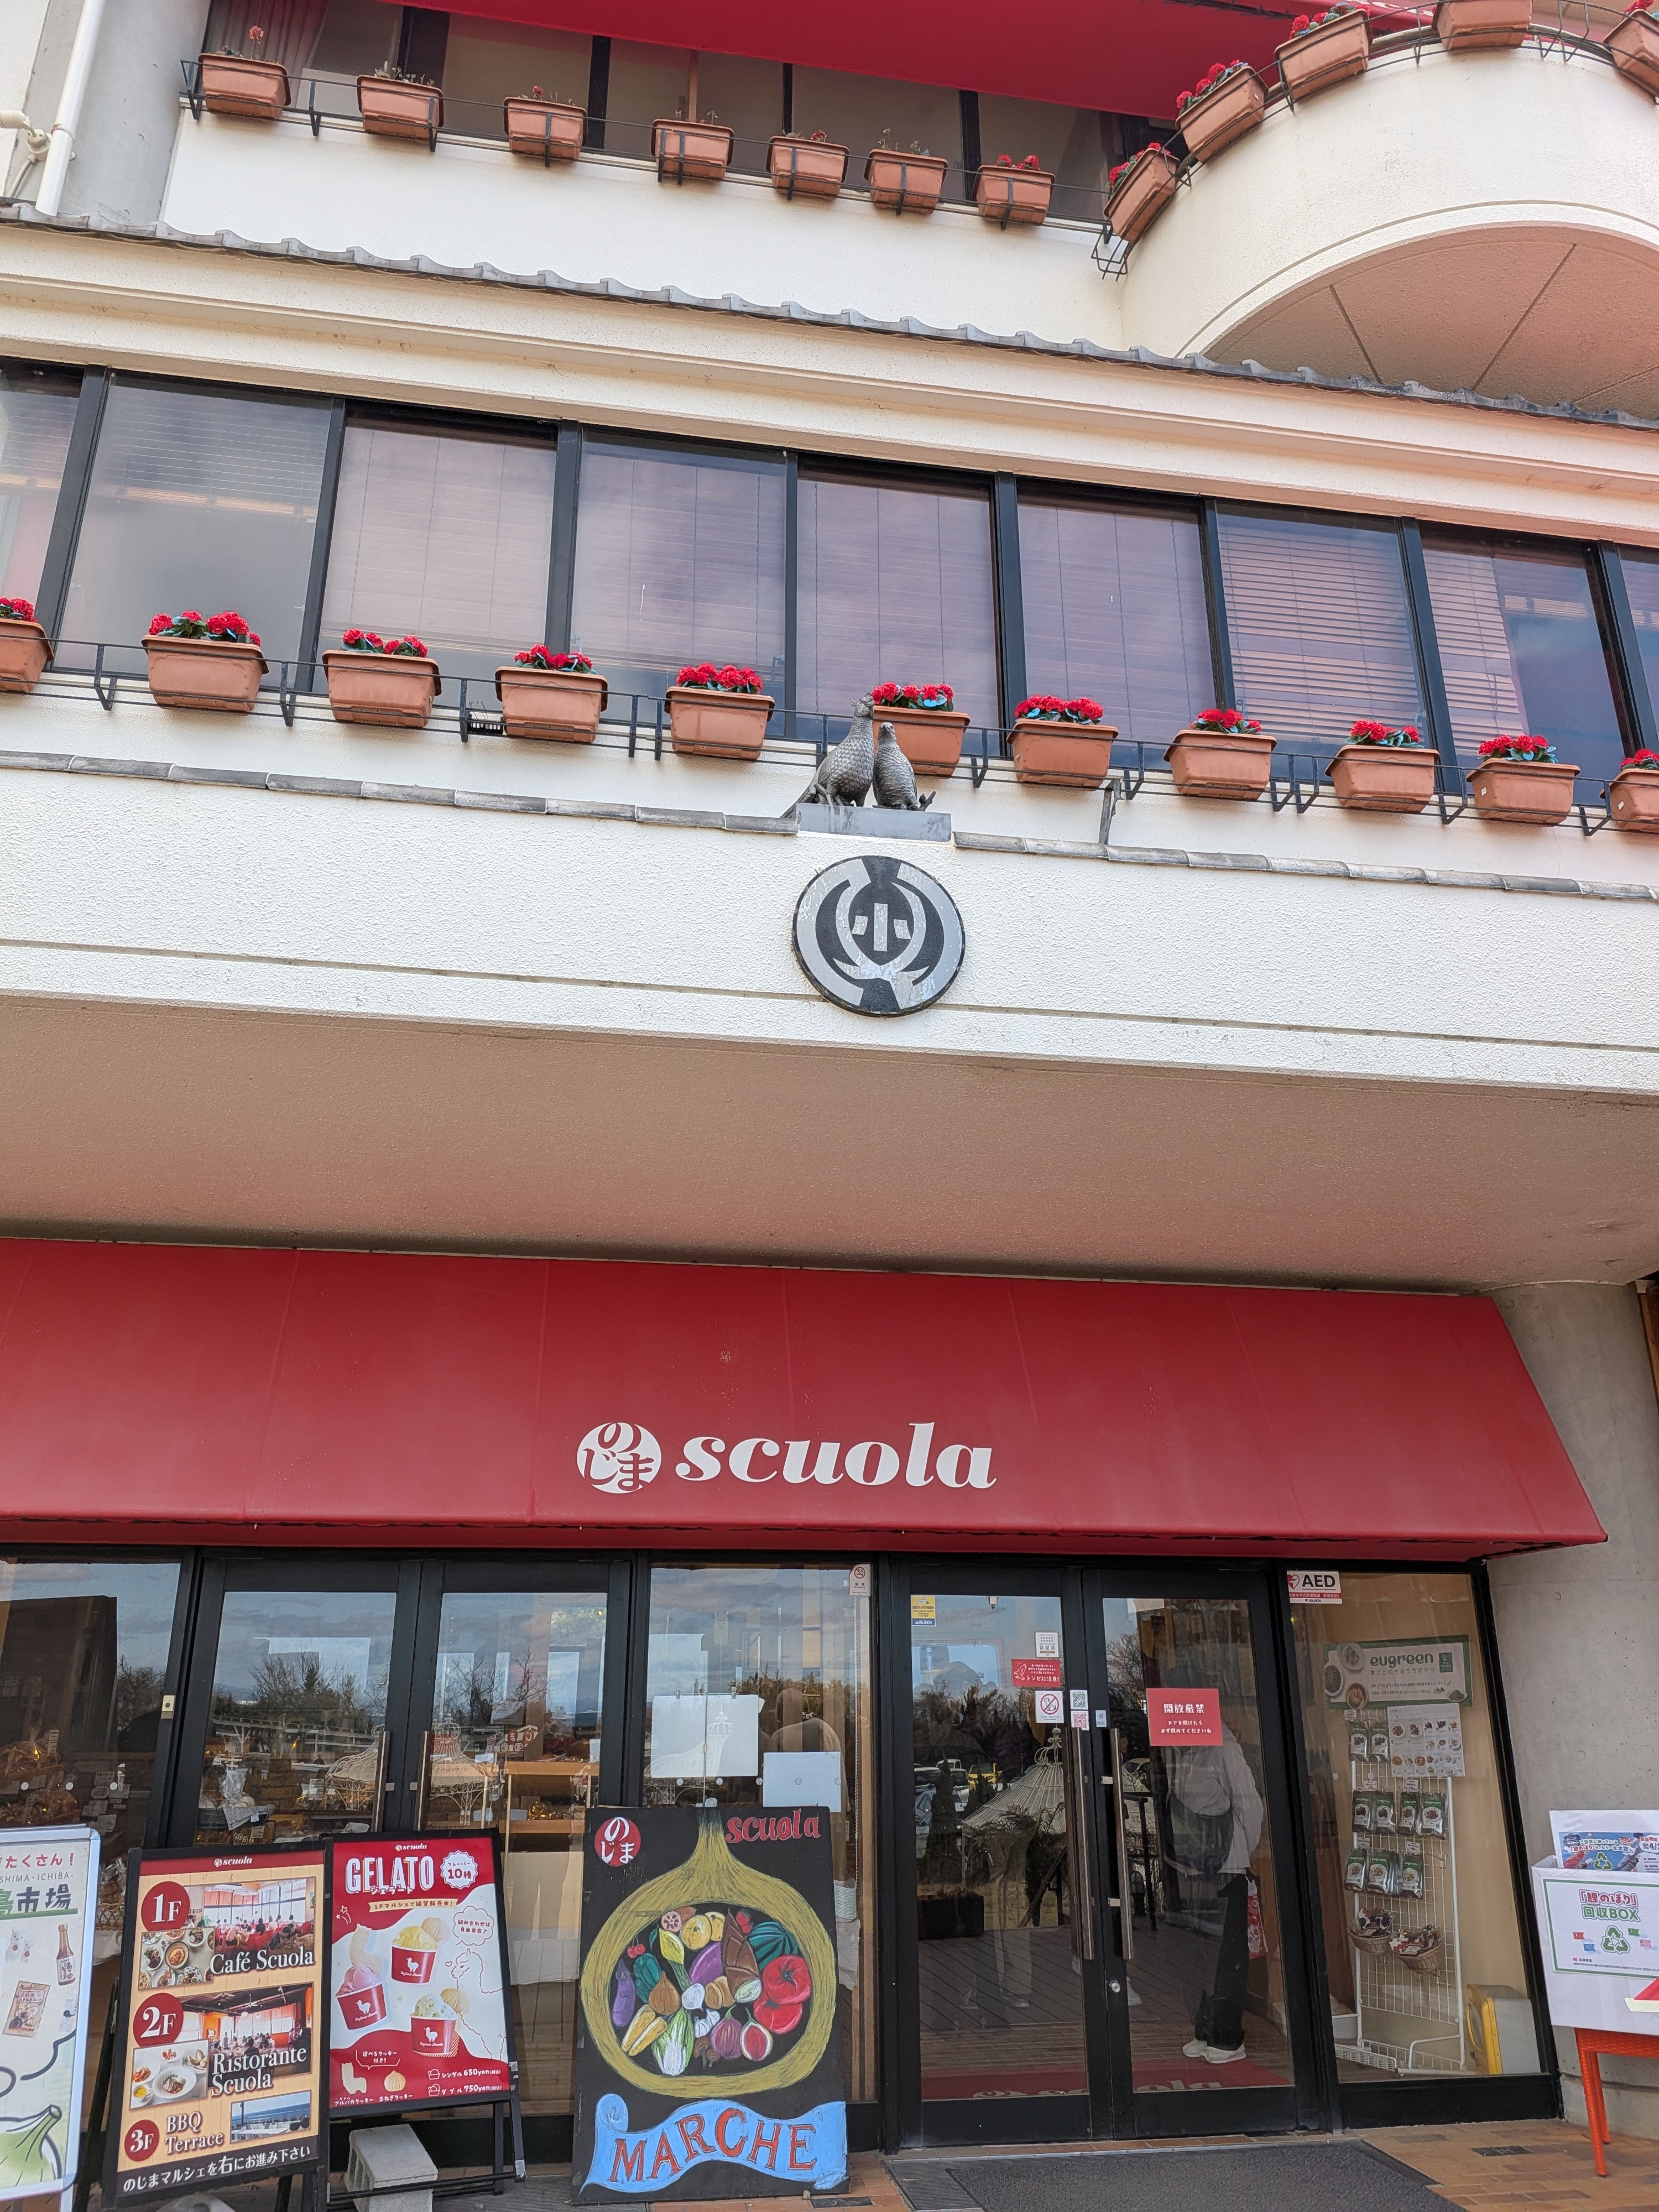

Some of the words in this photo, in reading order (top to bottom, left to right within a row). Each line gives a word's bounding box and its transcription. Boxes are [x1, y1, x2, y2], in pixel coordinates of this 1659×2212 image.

[675, 1422, 997, 1489] scuola
[1302, 1574, 1335, 1587] AED
[1370, 1653, 1434, 1668] eugreen
[1164, 1703, 1204, 1714] 開放厳禁
[726, 1809, 821, 1844] scuola
[0, 1853, 74, 1869] たくさん！
[223, 1855, 252, 1865] scuola
[346, 1856, 435, 1894] GELATO
[447, 1869, 472, 1879] 10種
[370, 1885, 413, 1895] ジェラート
[1580, 1891, 1638, 1906] 「鯉のぼり」
[152, 1893, 182, 1923] 1F
[1583, 1906, 1639, 1920] 回収BOX
[210, 1950, 251, 1975] Café
[256, 1947, 314, 1970] Scuola
[141, 2007, 177, 2038] 2F
[212, 2046, 307, 2076] Ristorante
[211, 2070, 273, 2096] Scuola
[166, 2110, 202, 2135] BBQ
[131, 2128, 155, 2152] 3F
[165, 2131, 223, 2154] Terrace
[609, 2107, 817, 2183] MARCHE
[123, 2145, 311, 2192] のじまマルシェを右にお進み下さい
